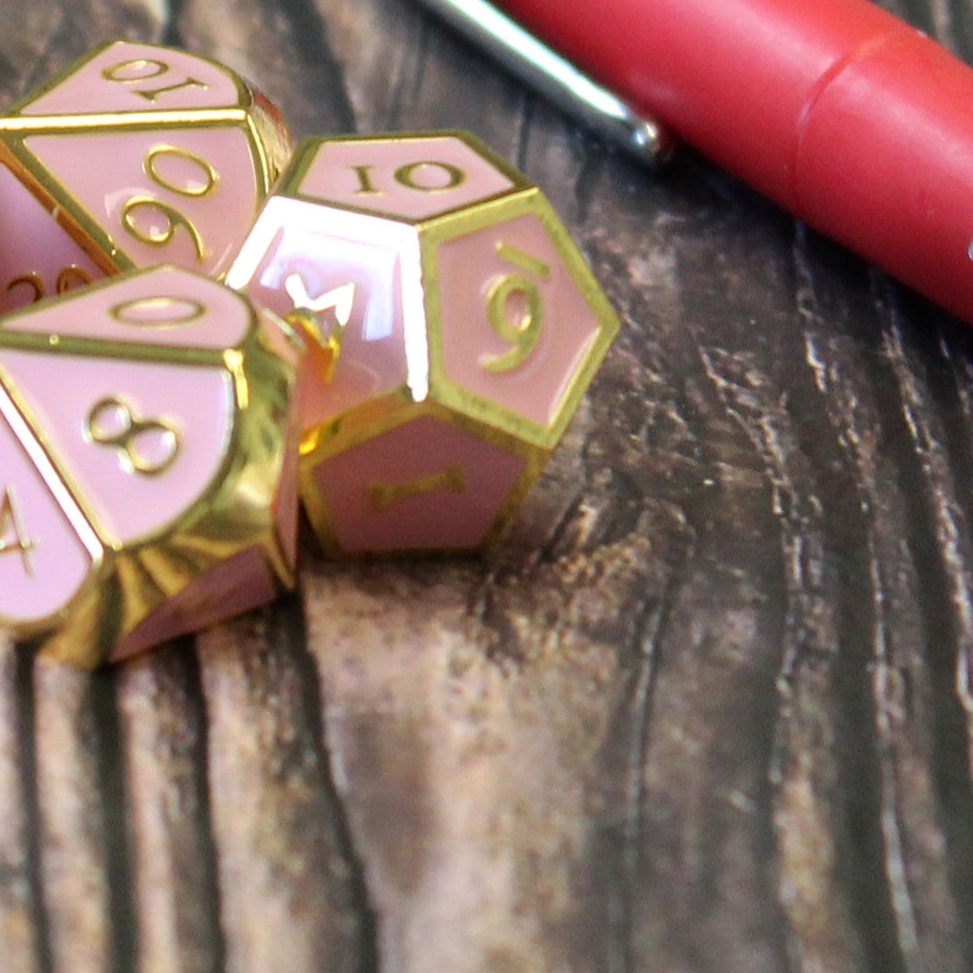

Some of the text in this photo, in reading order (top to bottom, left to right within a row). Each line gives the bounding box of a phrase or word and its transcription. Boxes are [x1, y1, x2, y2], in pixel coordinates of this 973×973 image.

[100, 58, 209, 104] 10
[347, 161, 468, 195] 10
[109, 295, 207, 331] 0
[84, 396, 183, 477] 8
[367, 460, 467, 510] 1
